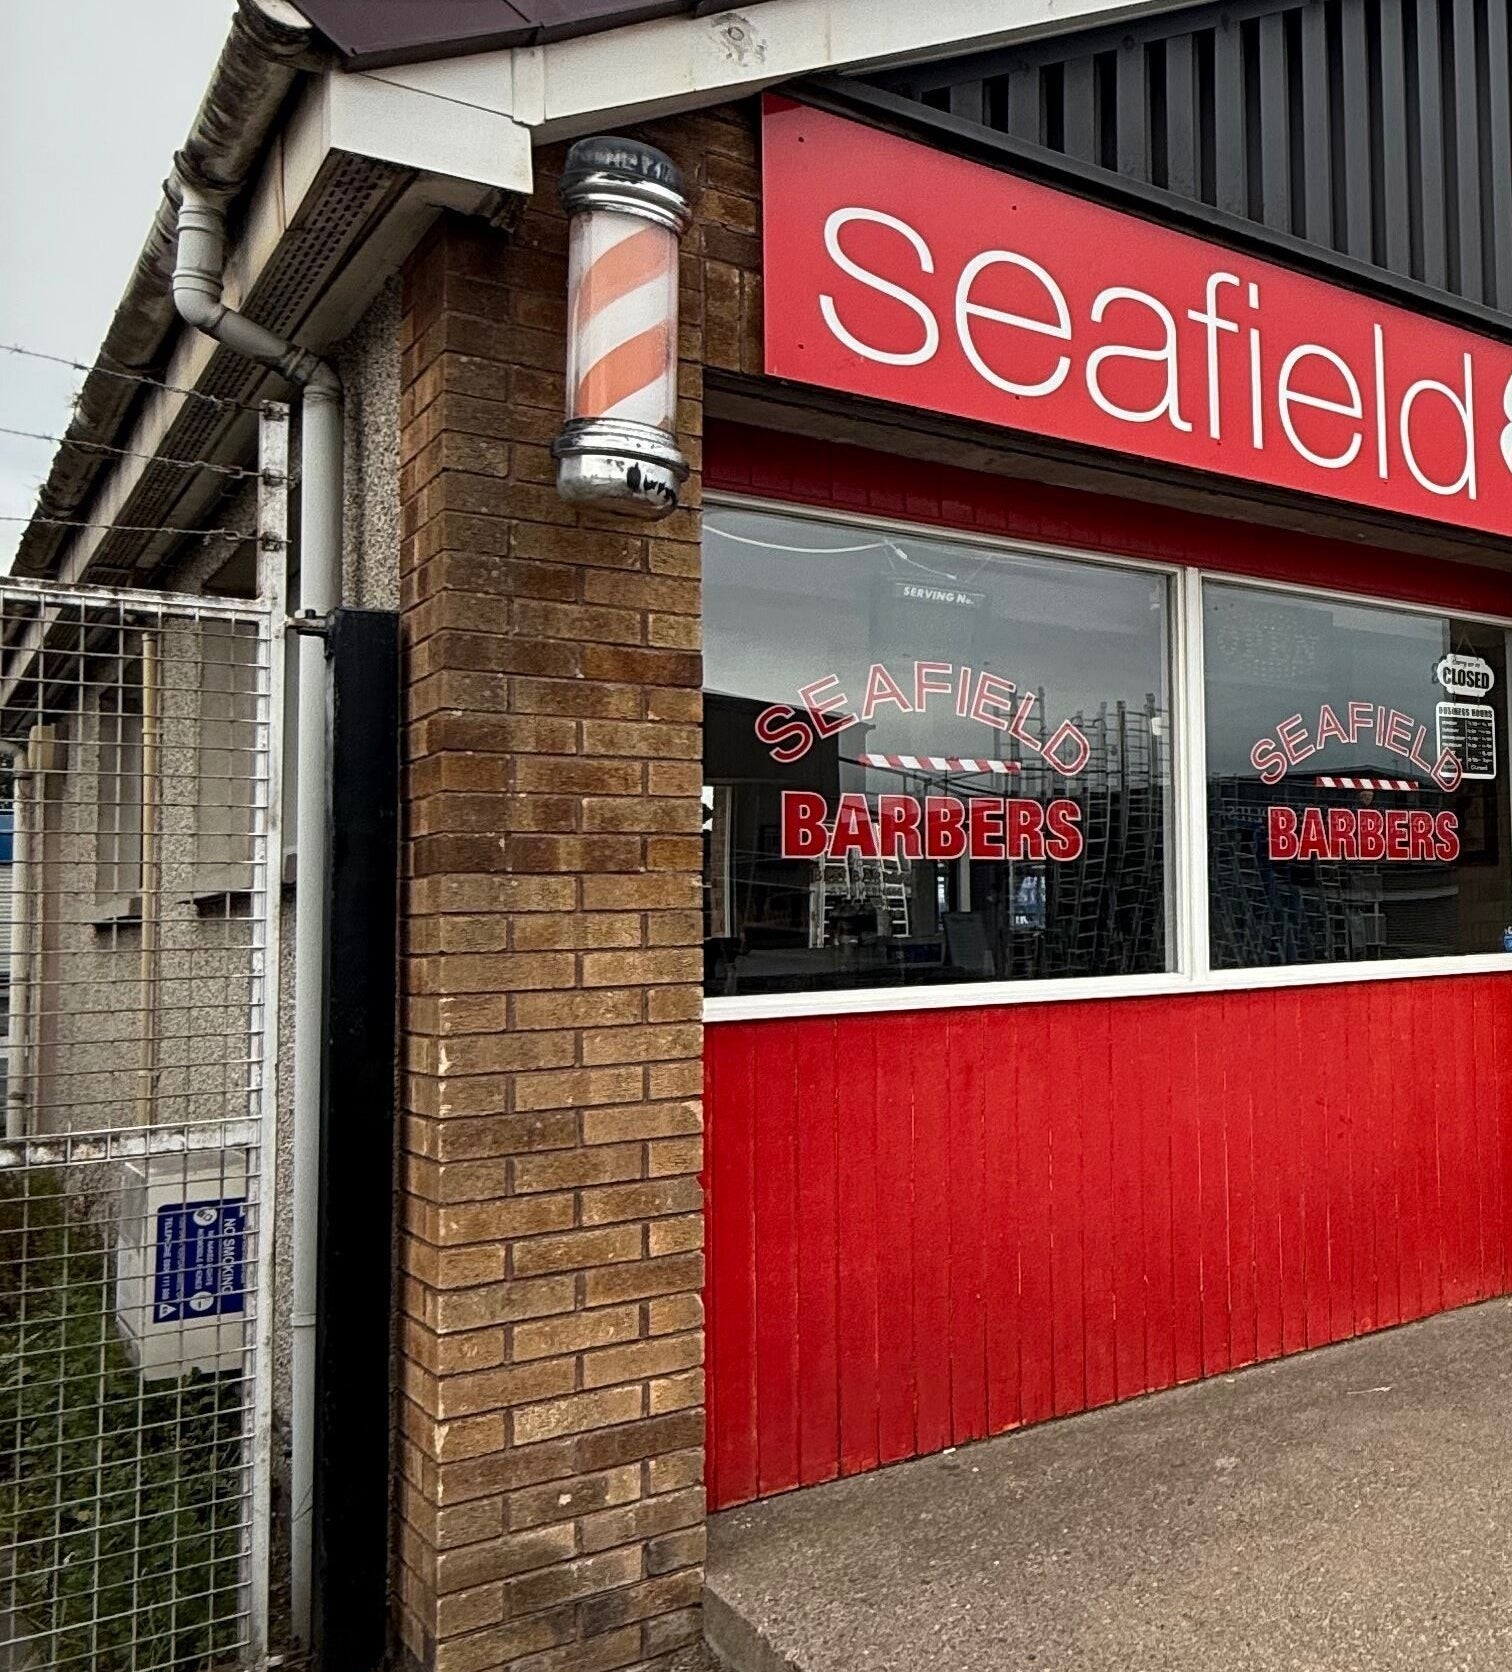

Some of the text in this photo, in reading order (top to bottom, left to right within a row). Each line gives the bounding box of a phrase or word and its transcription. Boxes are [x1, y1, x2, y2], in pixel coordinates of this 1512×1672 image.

[819, 206, 1478, 501] seafield
[903, 586, 955, 602] SERVING
[1442, 667, 1490, 689] CLOSED
[755, 661, 1091, 777] SEAFIELD
[1250, 701, 1463, 793] SEAFIELD
[780, 790, 1084, 861] BARBERS
[1267, 807, 1461, 862] BARBERS
